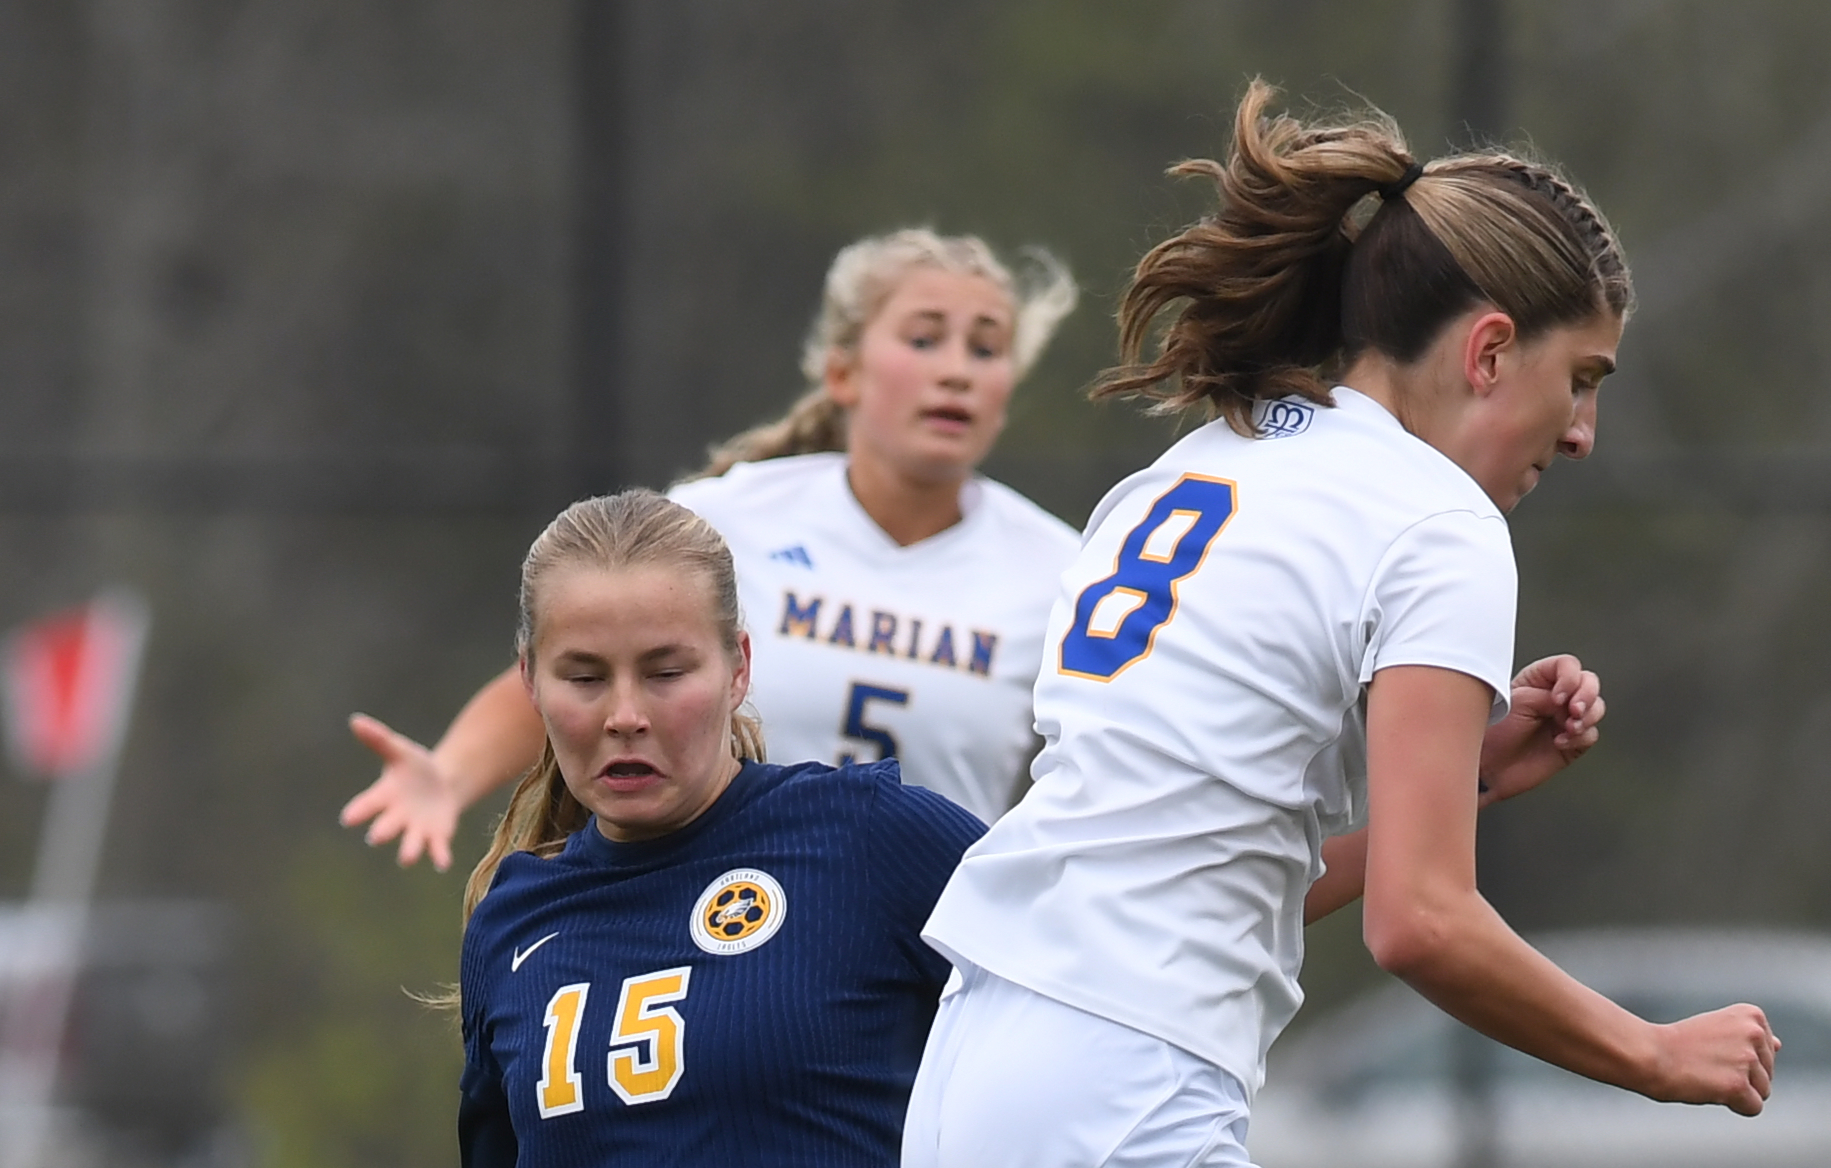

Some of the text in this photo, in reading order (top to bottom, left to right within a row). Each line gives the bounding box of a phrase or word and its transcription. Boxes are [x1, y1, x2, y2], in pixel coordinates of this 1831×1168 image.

[777, 590, 998, 678] MARIAN
[1058, 472, 1238, 683] 8
[836, 680, 910, 765] 5
[536, 966, 692, 1119] 15
